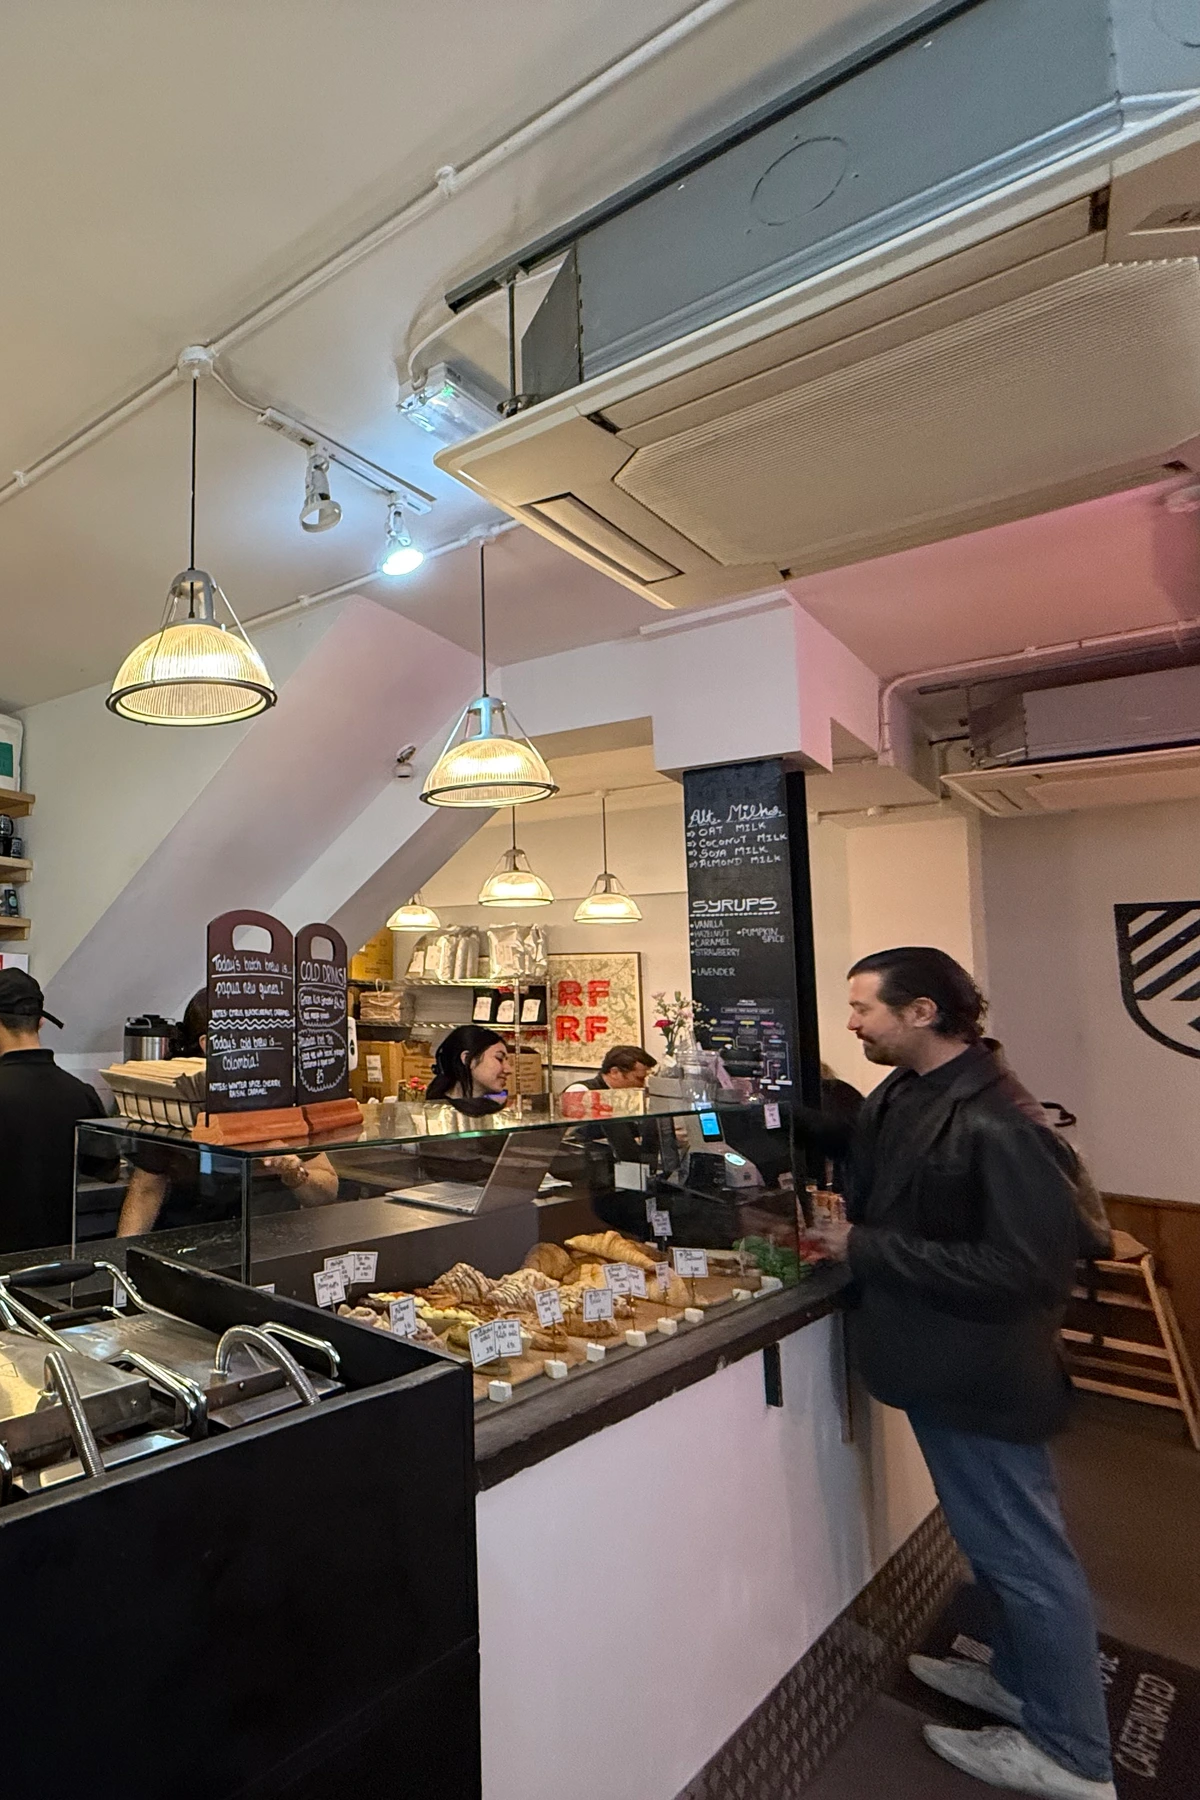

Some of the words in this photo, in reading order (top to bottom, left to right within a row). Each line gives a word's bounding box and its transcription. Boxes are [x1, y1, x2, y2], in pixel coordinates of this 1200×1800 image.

[698, 826, 723, 837] OAT
[735, 821, 767, 833] MILK
[698, 835, 747, 848] COCONUT
[756, 833, 788, 843] MILK
[698, 849, 727, 858] SOYA
[734, 845, 769, 856] MILK
[699, 857, 743, 868] ALMOND
[750, 854, 782, 864] MILK
[692, 896, 778, 914] SYRUPS
[694, 919, 724, 930] VANILLA
[694, 928, 731, 938] HAZELNUT
[741, 927, 779, 937] PUMPKIN
[761, 934, 785, 943] SPICE
[694, 938, 731, 948] CARAMEL
[694, 948, 741, 957] STRAWBERRY
[212, 953, 241, 974] Today's
[300, 960, 320, 982] COLD
[696, 966, 736, 977] LAVENDER
[209, 1033, 237, 1054] Today's
[222, 1051, 260, 1071] Colombia!
